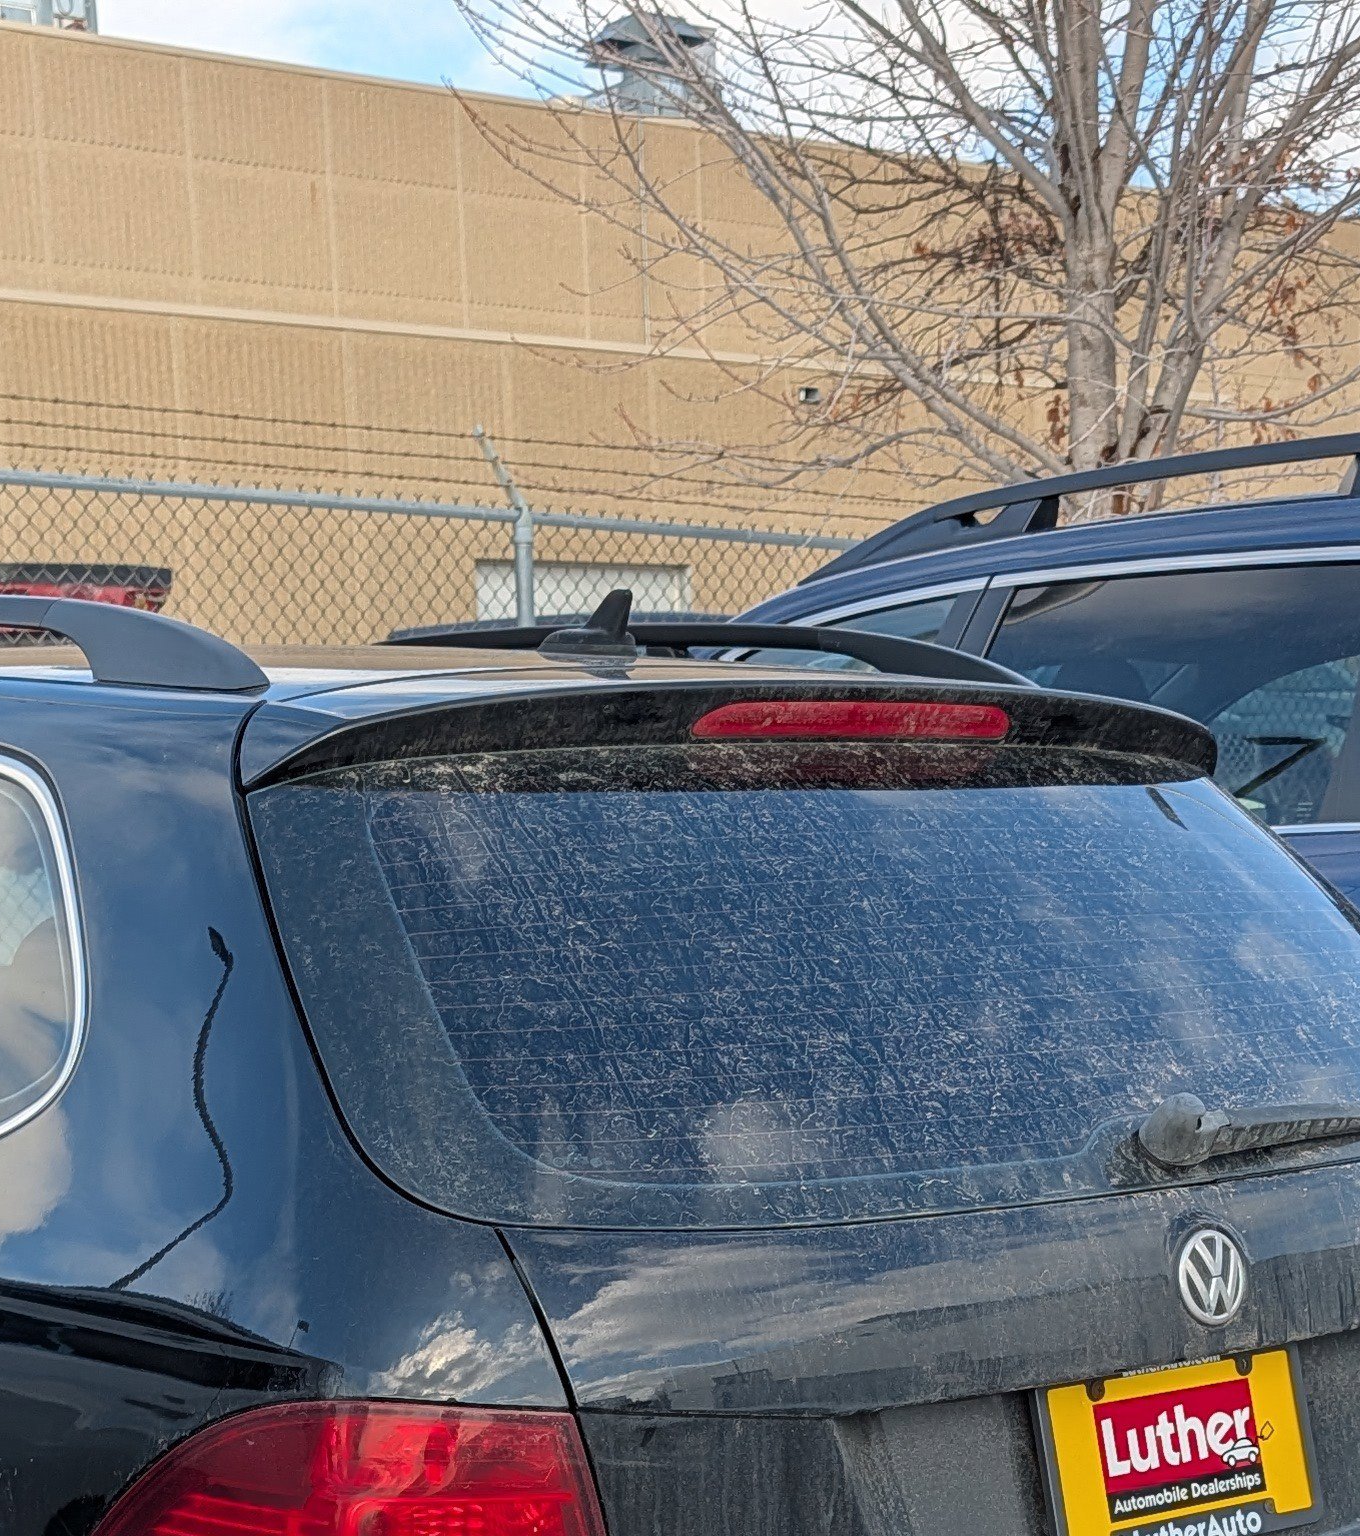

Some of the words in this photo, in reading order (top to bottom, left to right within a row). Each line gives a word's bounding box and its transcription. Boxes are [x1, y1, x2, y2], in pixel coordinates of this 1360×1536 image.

[1100, 1404, 1251, 1478] Luther
[1113, 1486, 1189, 1515] Automobile
[1191, 1471, 1262, 1499] Dealerships
